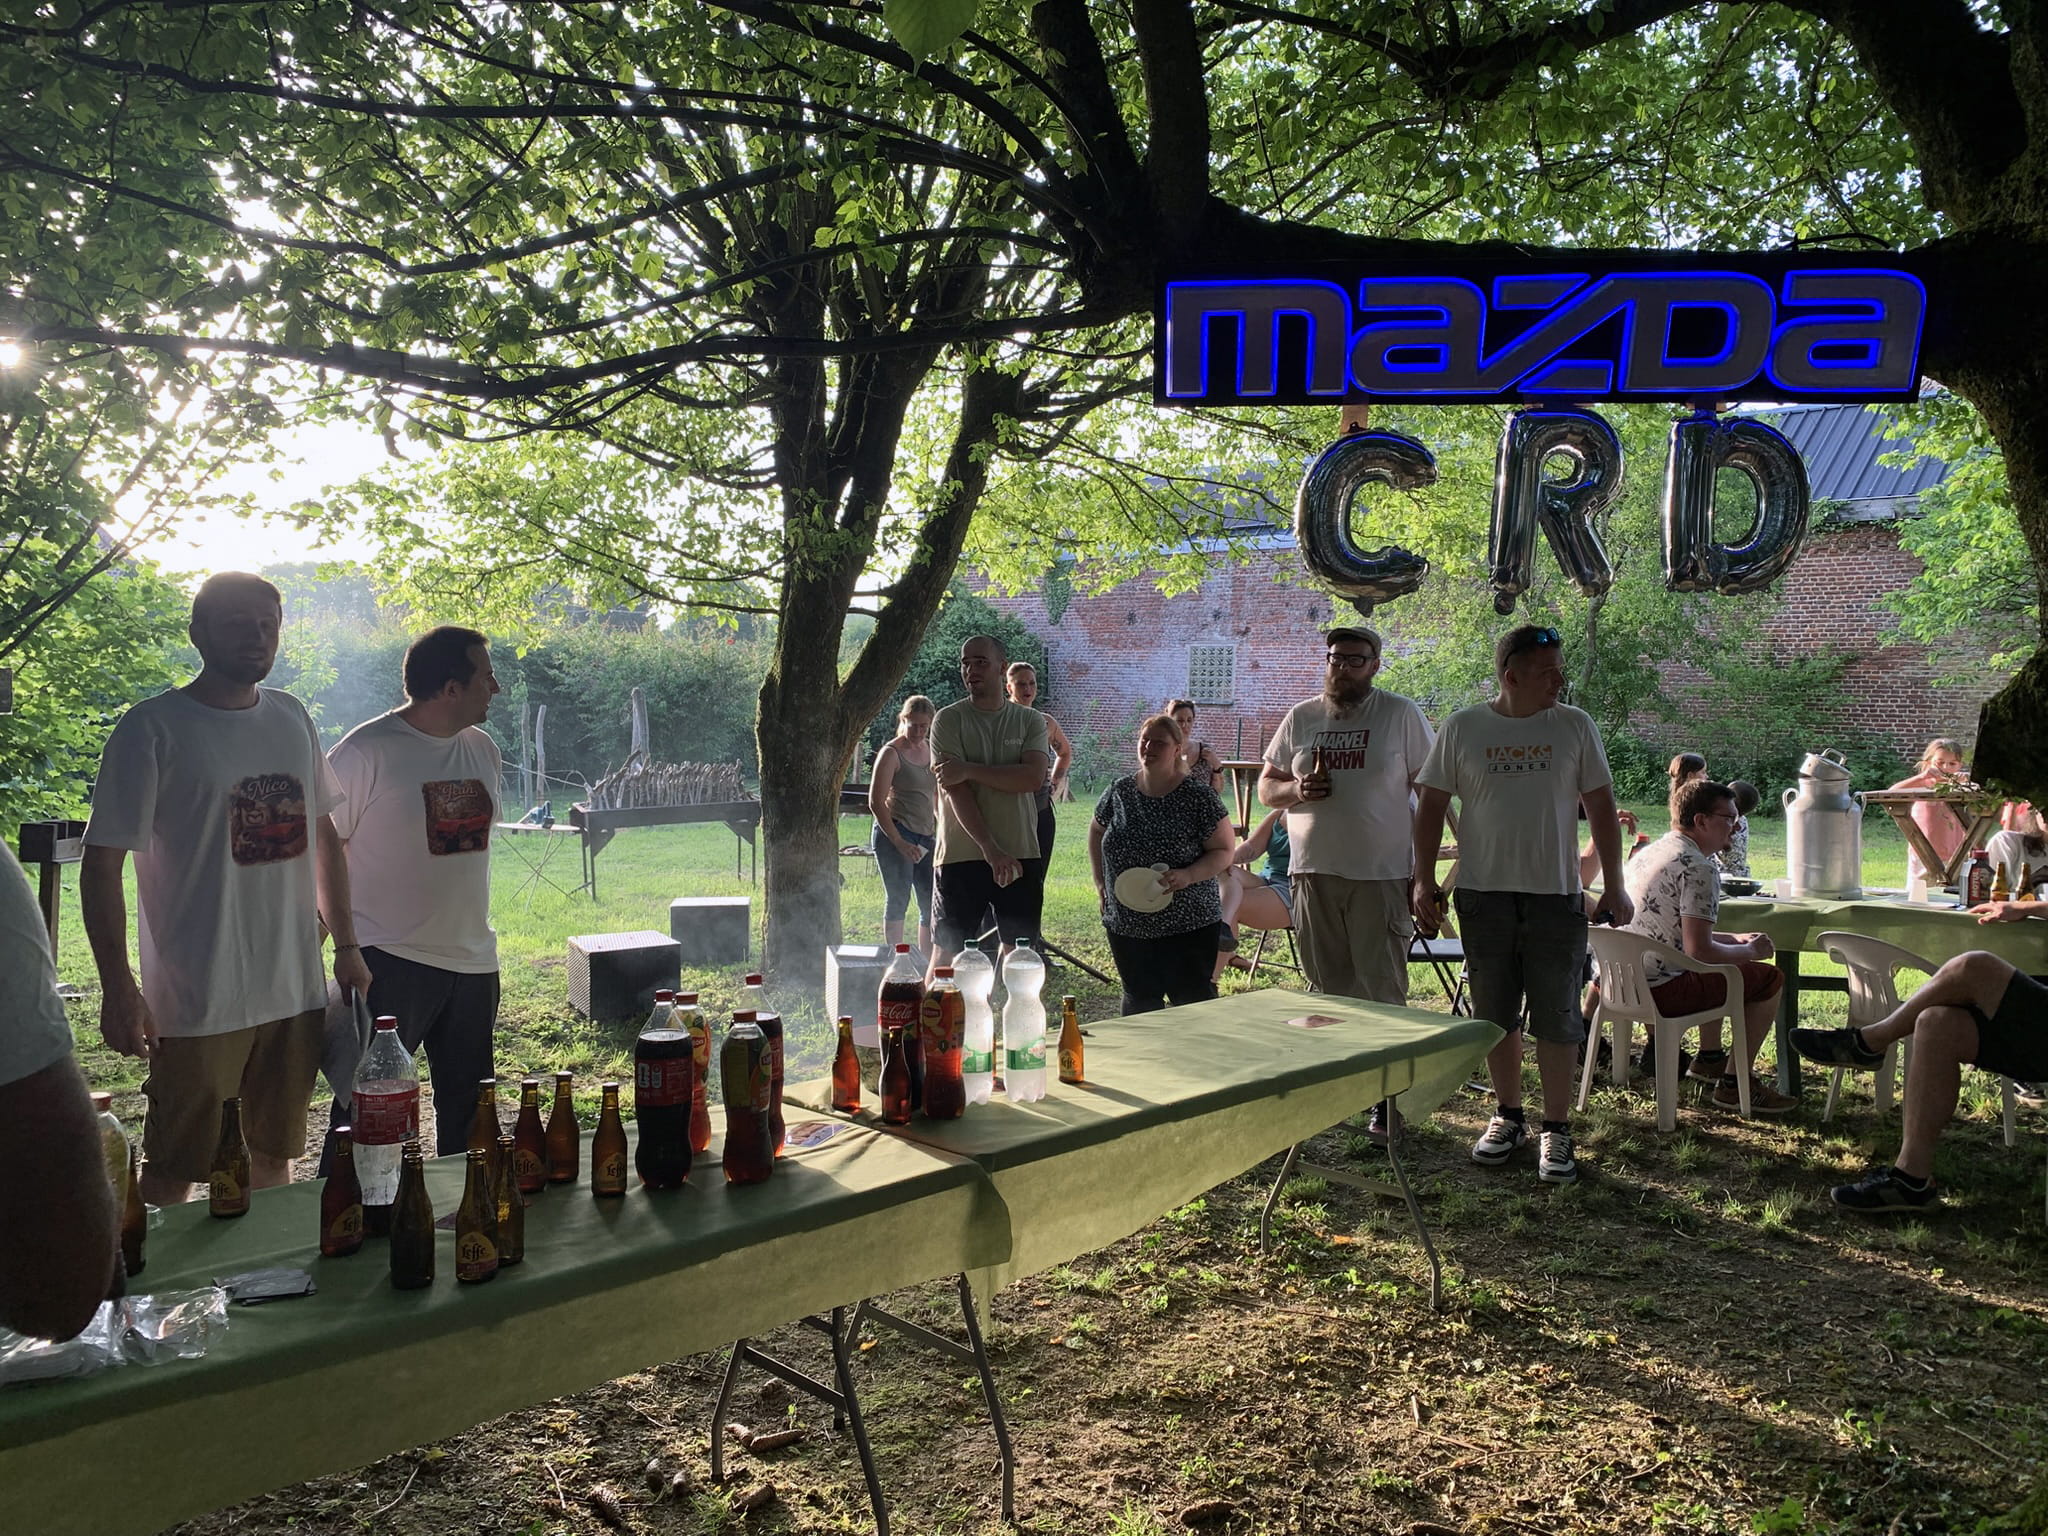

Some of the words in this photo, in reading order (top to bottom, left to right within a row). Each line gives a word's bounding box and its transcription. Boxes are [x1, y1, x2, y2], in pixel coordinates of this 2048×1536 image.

[1312, 731, 1367, 749] MARVEL
[1492, 762, 1547, 771] JONES
[247, 778, 289, 801] Nico
